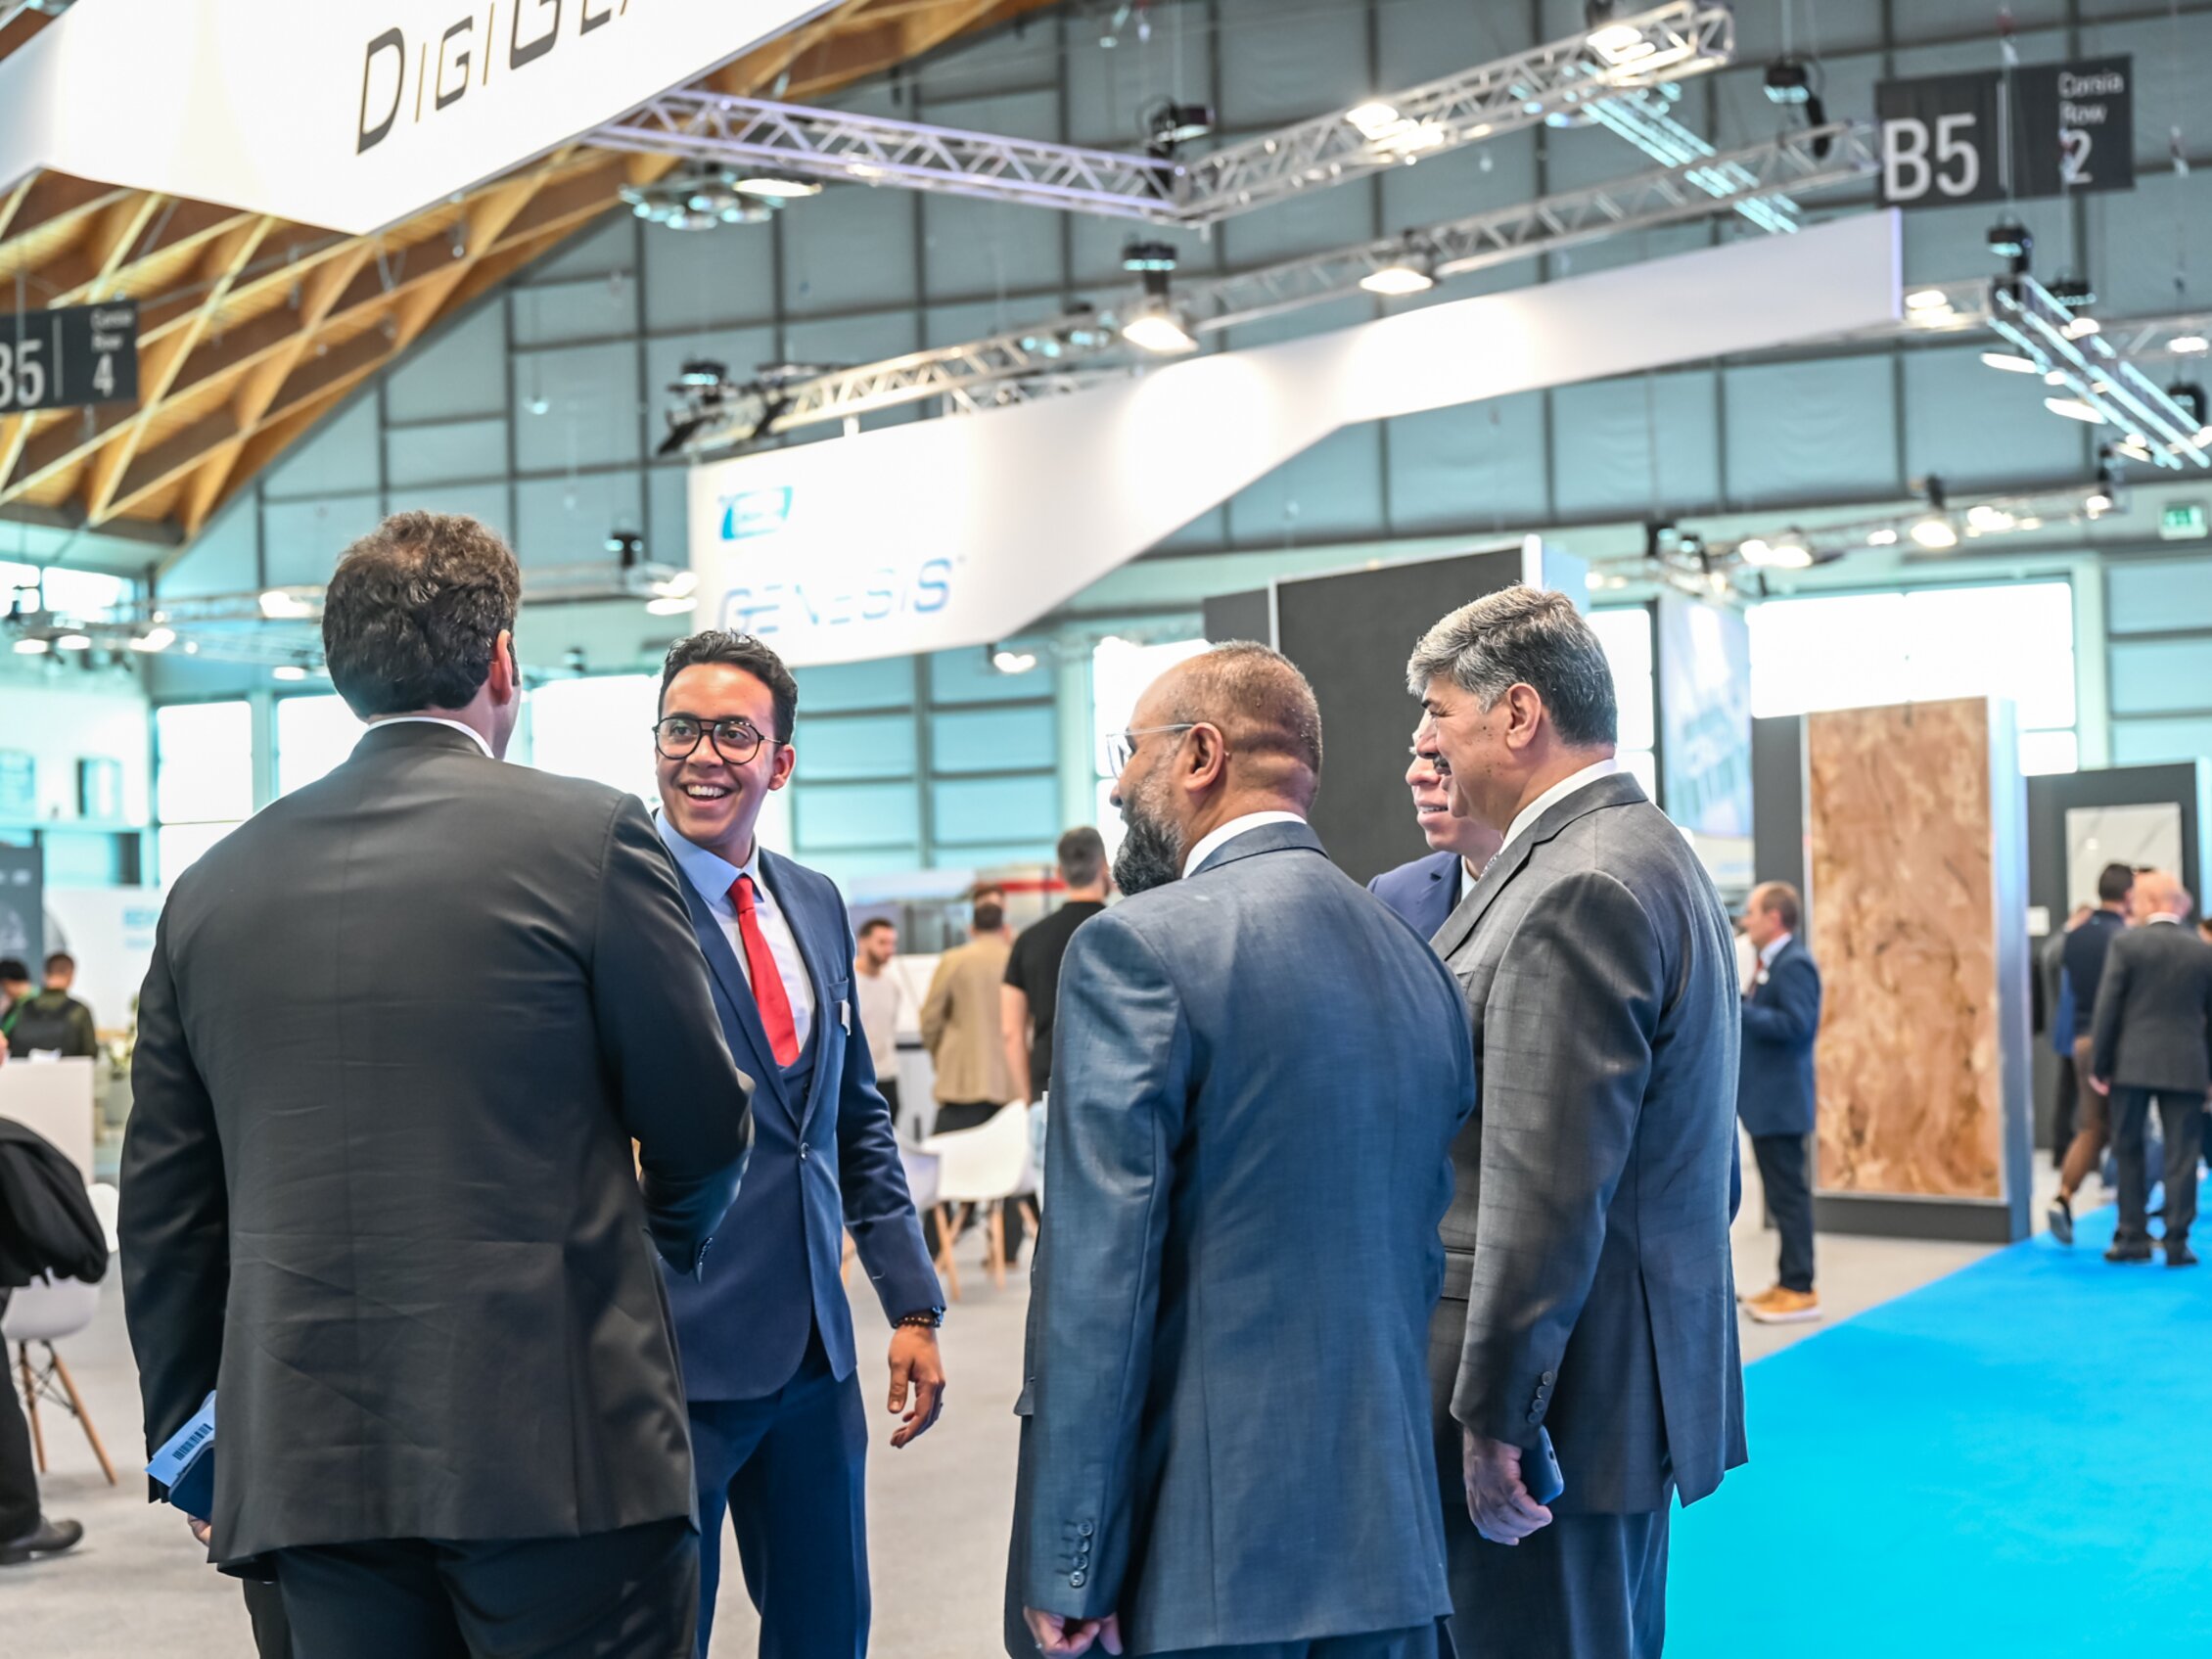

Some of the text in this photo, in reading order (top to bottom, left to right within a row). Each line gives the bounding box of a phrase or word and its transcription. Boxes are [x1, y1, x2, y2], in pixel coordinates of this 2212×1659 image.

[1882, 113, 1980, 202] B5
[2060, 129, 2093, 184] 2
[93, 352, 115, 397] 4
